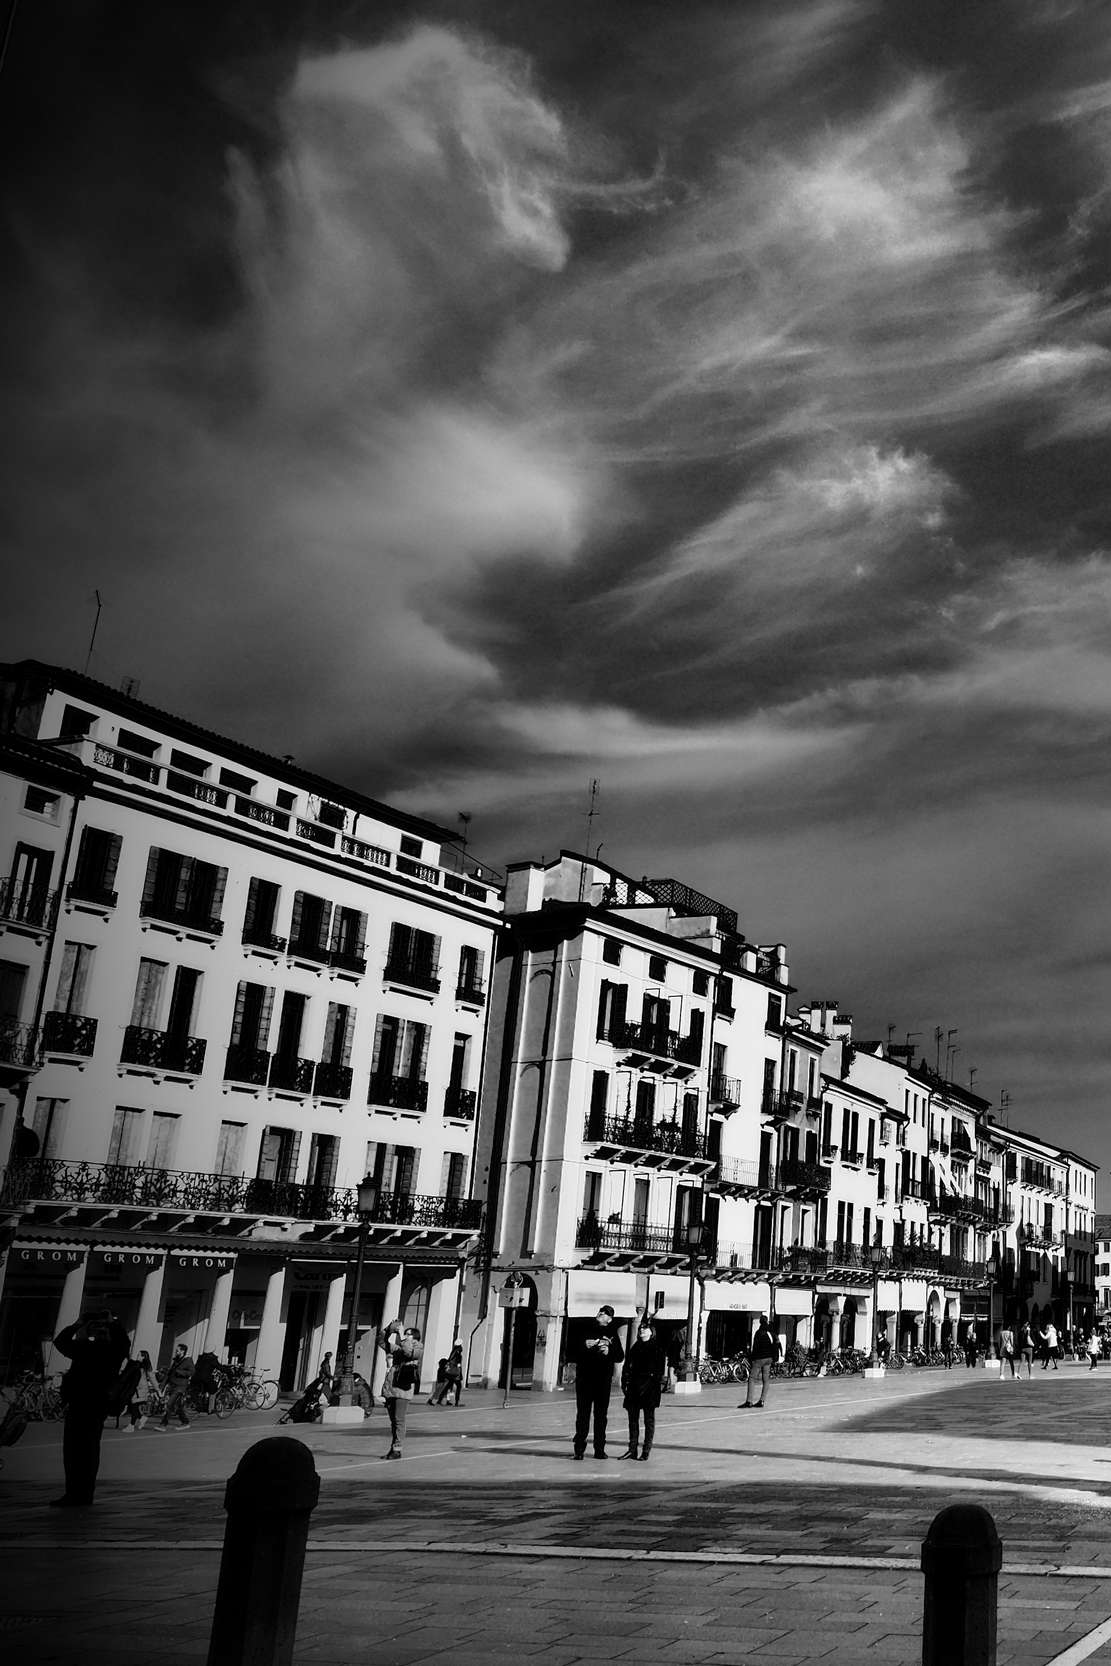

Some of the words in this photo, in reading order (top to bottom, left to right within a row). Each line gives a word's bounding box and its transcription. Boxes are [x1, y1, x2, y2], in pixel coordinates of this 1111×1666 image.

[20, 1249, 78, 1262] GROM
[103, 1253, 156, 1265] GROM
[178, 1256, 228, 1268] GROM
